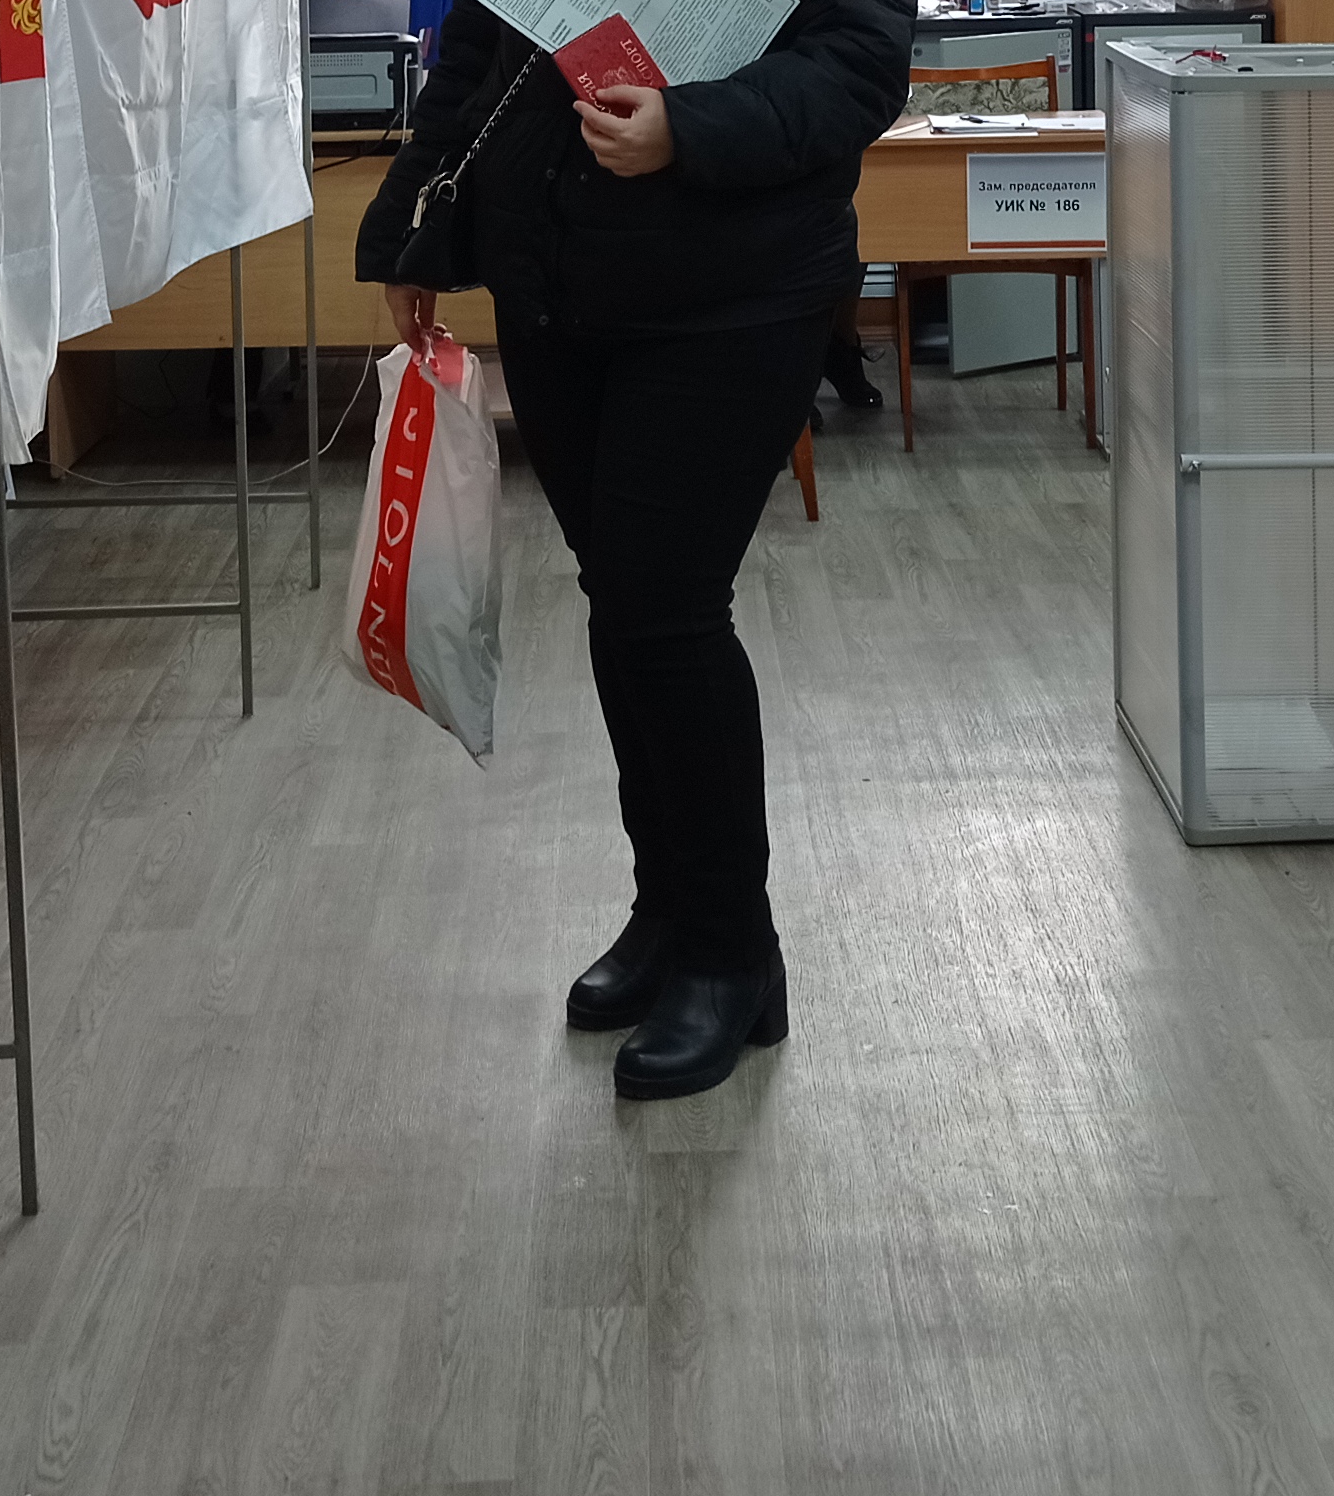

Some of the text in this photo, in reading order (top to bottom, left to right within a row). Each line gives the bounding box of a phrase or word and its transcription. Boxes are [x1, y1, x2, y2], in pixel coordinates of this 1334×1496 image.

[978, 181, 1096, 193] Зам. председателя
[995, 199, 1080, 212] УИК № 186
